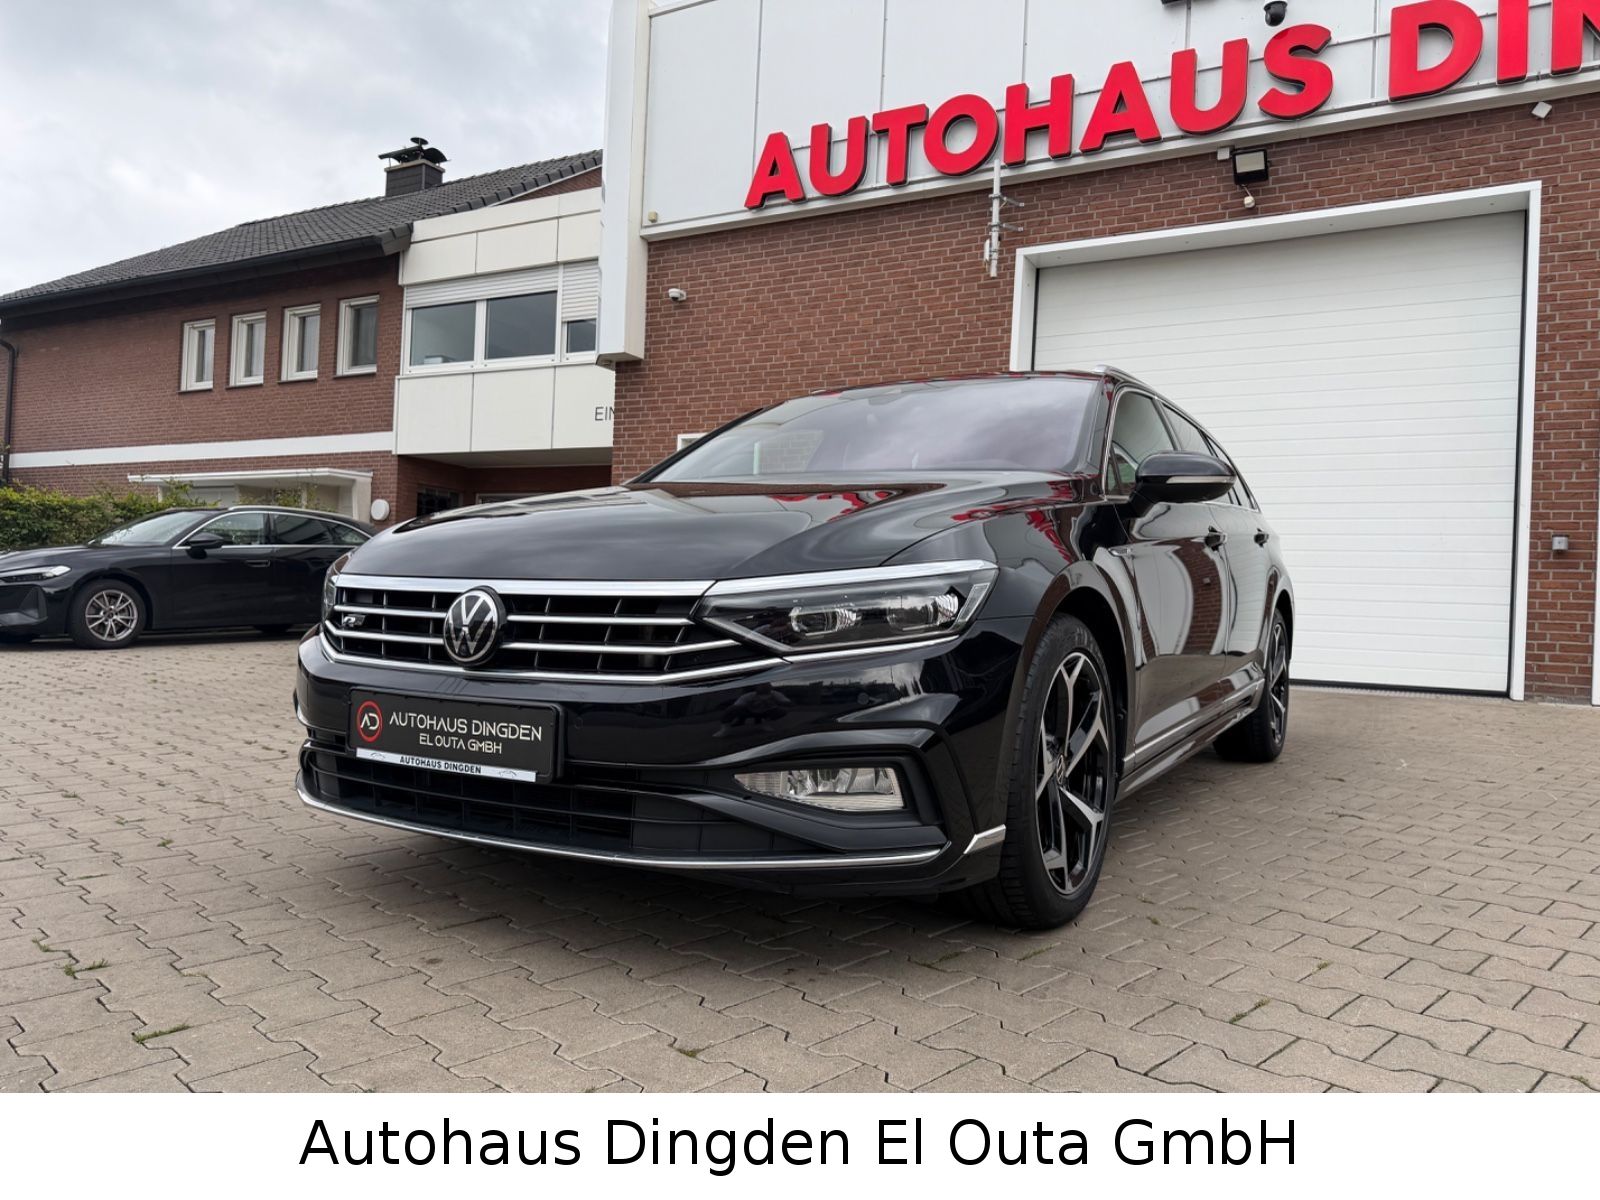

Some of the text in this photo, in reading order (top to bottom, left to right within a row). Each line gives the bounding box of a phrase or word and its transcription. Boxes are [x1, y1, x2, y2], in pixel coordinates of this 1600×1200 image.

[744, 24, 1333, 210] AUTOHAUS
[389, 711, 542, 742] AUTOHAUS DINGDEN
[419, 733, 502, 754] EL OUTA GMBH
[400, 756, 482, 775] AUTOHAUS DINGDEN
